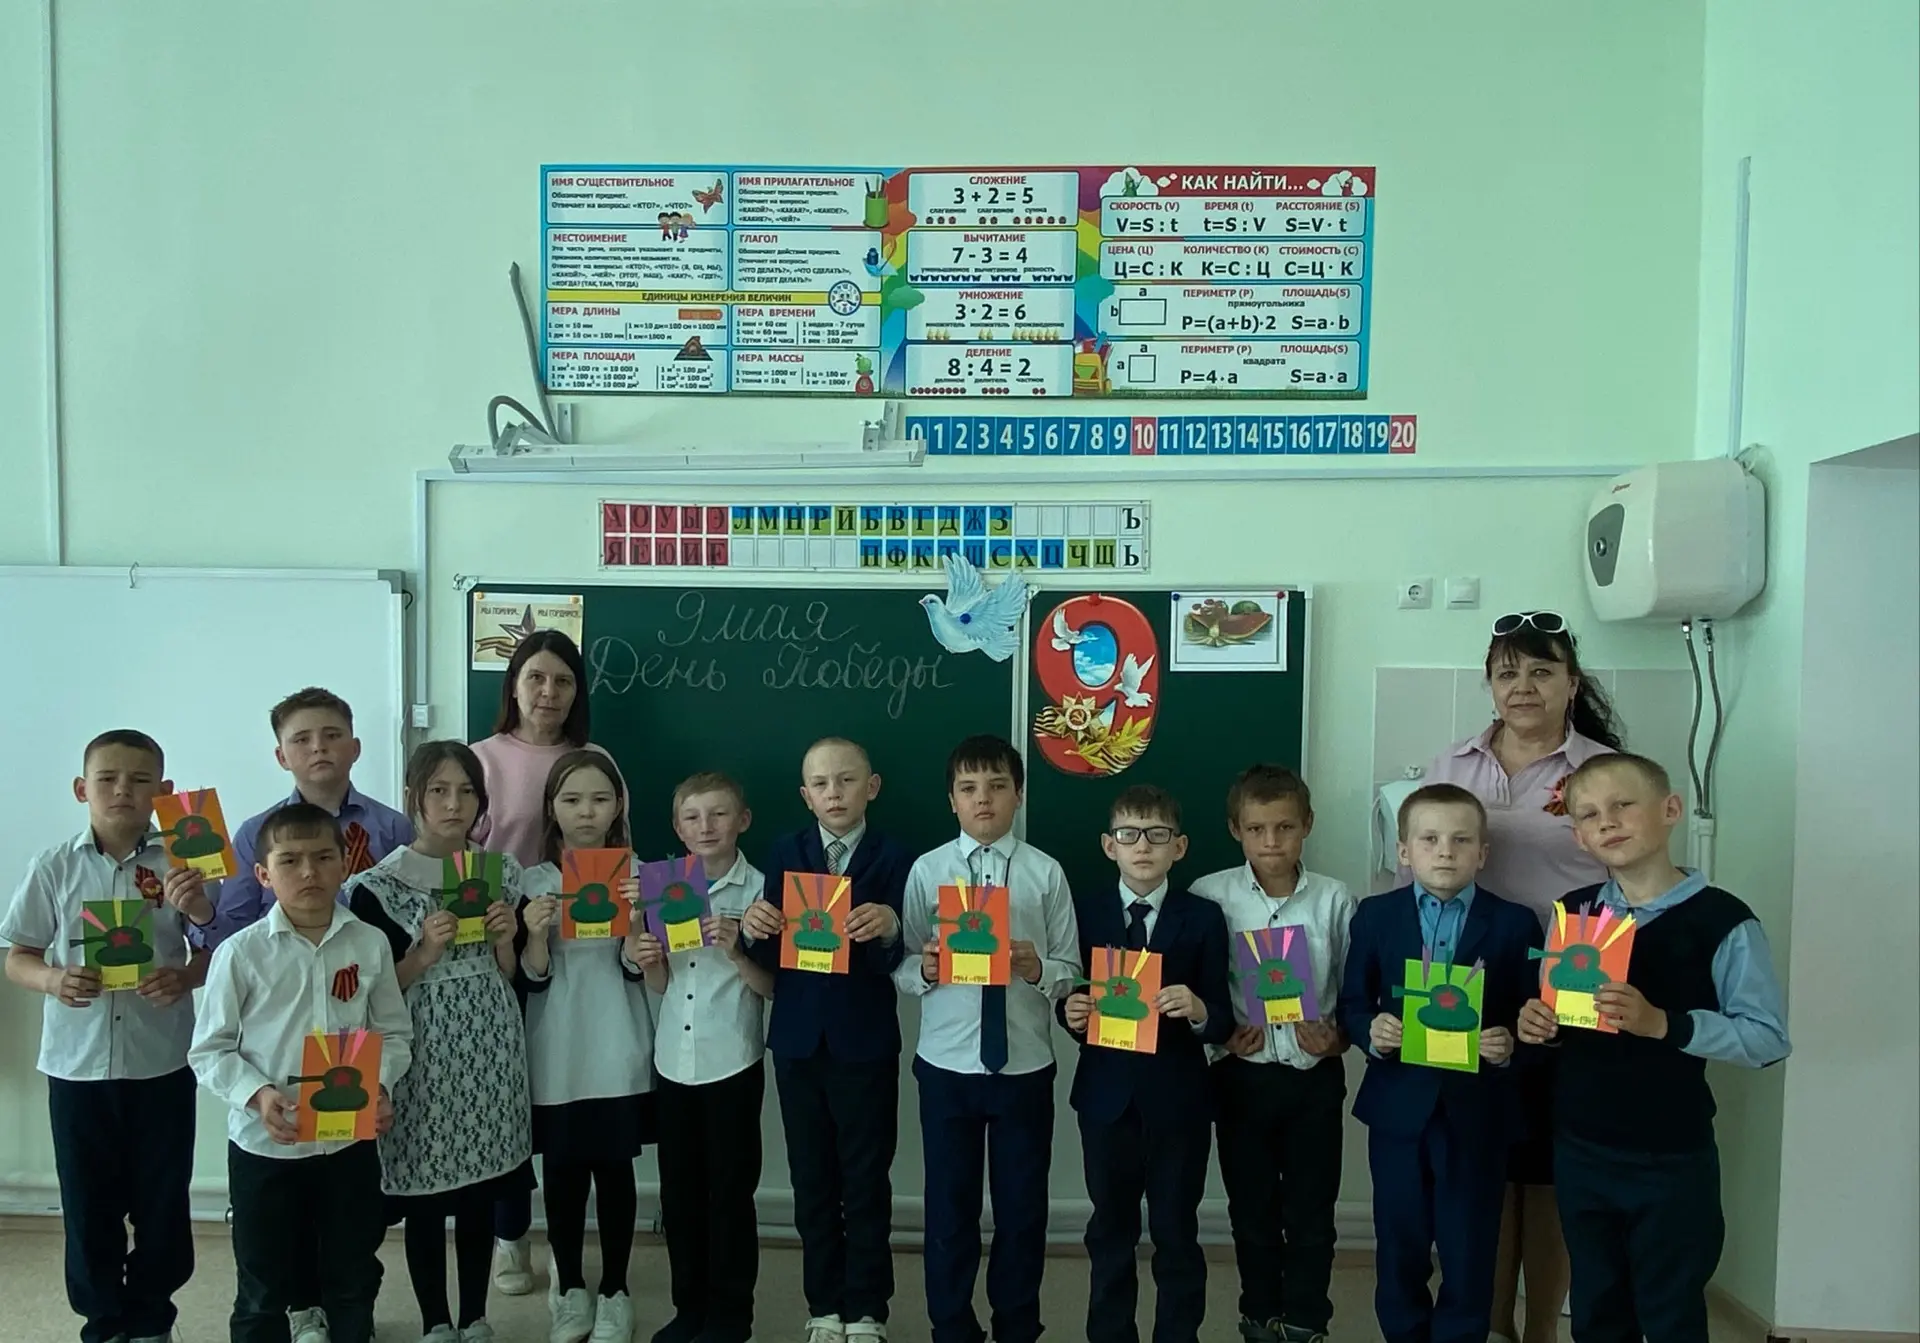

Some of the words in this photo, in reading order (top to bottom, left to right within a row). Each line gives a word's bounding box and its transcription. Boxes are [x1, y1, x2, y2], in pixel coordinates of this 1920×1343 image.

[552, 178, 573, 186] ИМЯ
[576, 178, 674, 187] СУЩЕСТВИТЕЛЬНОЕ
[764, 178, 855, 186] ПРИЛАГАТЕЛЬНОЕ
[970, 176, 1026, 184] СЛОЖЕНИЕ
[1181, 175, 1218, 190] КАК
[1224, 171, 1303, 190] НАЙТИ...
[954, 188, 964, 204] 3
[988, 188, 999, 203] 2
[1022, 188, 1033, 204] 5
[1109, 202, 1162, 211] СКОРОСТЬ
[1165, 202, 1180, 212] (V)
[1205, 202, 1239, 211] ВРЕМЯ
[1276, 202, 1342, 211] РАССТОЯНИЕ
[1345, 202, 1360, 212] (S)
[553, 234, 627, 242] МЕСТОИМЕНИЕ
[740, 235, 777, 243] ГЛАГОЛ
[964, 234, 1025, 242] ВЫЧИТАНИЕ
[1108, 246, 1135, 256] ЦЕНА
[1184, 246, 1250, 255] КОЛИЧЕСТВО
[1279, 247, 1341, 255] СТОИМОСТЬ
[953, 248, 964, 263] 7
[981, 248, 992, 263] 3
[1016, 248, 1027, 263] 4
[642, 293, 688, 301] ЕДИНИЦЫ
[691, 293, 745, 302] ИЗМЕРЕНИЯ
[748, 294, 791, 302] ВЕЛИЧИН
[959, 291, 1023, 300] УМНОЖЕНИЕ
[1184, 289, 1236, 297] ПЕРИМЕТР
[1228, 300, 1305, 308] прямоугольника
[583, 308, 620, 316] ДЛИНЫ
[770, 309, 815, 317] ВРЕМЕНИ
[956, 304, 966, 319] 3
[982, 304, 992, 319] 2
[1015, 304, 1025, 319] 6
[966, 349, 1012, 358] ДЕЛЕНИЕ
[1181, 346, 1234, 354] ПЕРИМЕТР
[584, 353, 635, 361] ПЛОЩАДИ
[737, 354, 763, 362] МЕРА
[1243, 358, 1285, 366] квадрата
[948, 359, 960, 376] 8
[980, 359, 992, 376] 4
[1018, 359, 1030, 376] 2
[934, 424, 942, 449] 1
[955, 424, 967, 449] 2
[978, 424, 989, 449] 3
[1000, 424, 1013, 449] 4
[1023, 424, 1034, 449] 5
[1046, 424, 1058, 449] 6
[1068, 424, 1081, 449] 7
[1091, 423, 1103, 449] 8
[1114, 423, 1126, 449] 9
[1135, 423, 1154, 449] 10
[1160, 423, 1178, 449] 11
[1186, 423, 1206, 449] 12
[1212, 423, 1231, 449] 13
[1237, 423, 1258, 448] 14
[1264, 423, 1283, 448] 15
[1290, 423, 1310, 448] 16
[1316, 422, 1336, 448] 17
[1342, 422, 1362, 448] 18
[1368, 422, 1388, 448] 19
[1391, 422, 1414, 448] 20
[658, 591, 705, 646] 9
[701, 601, 858, 642] мая
[589, 636, 726, 694] День
[763, 642, 954, 719] Победы
